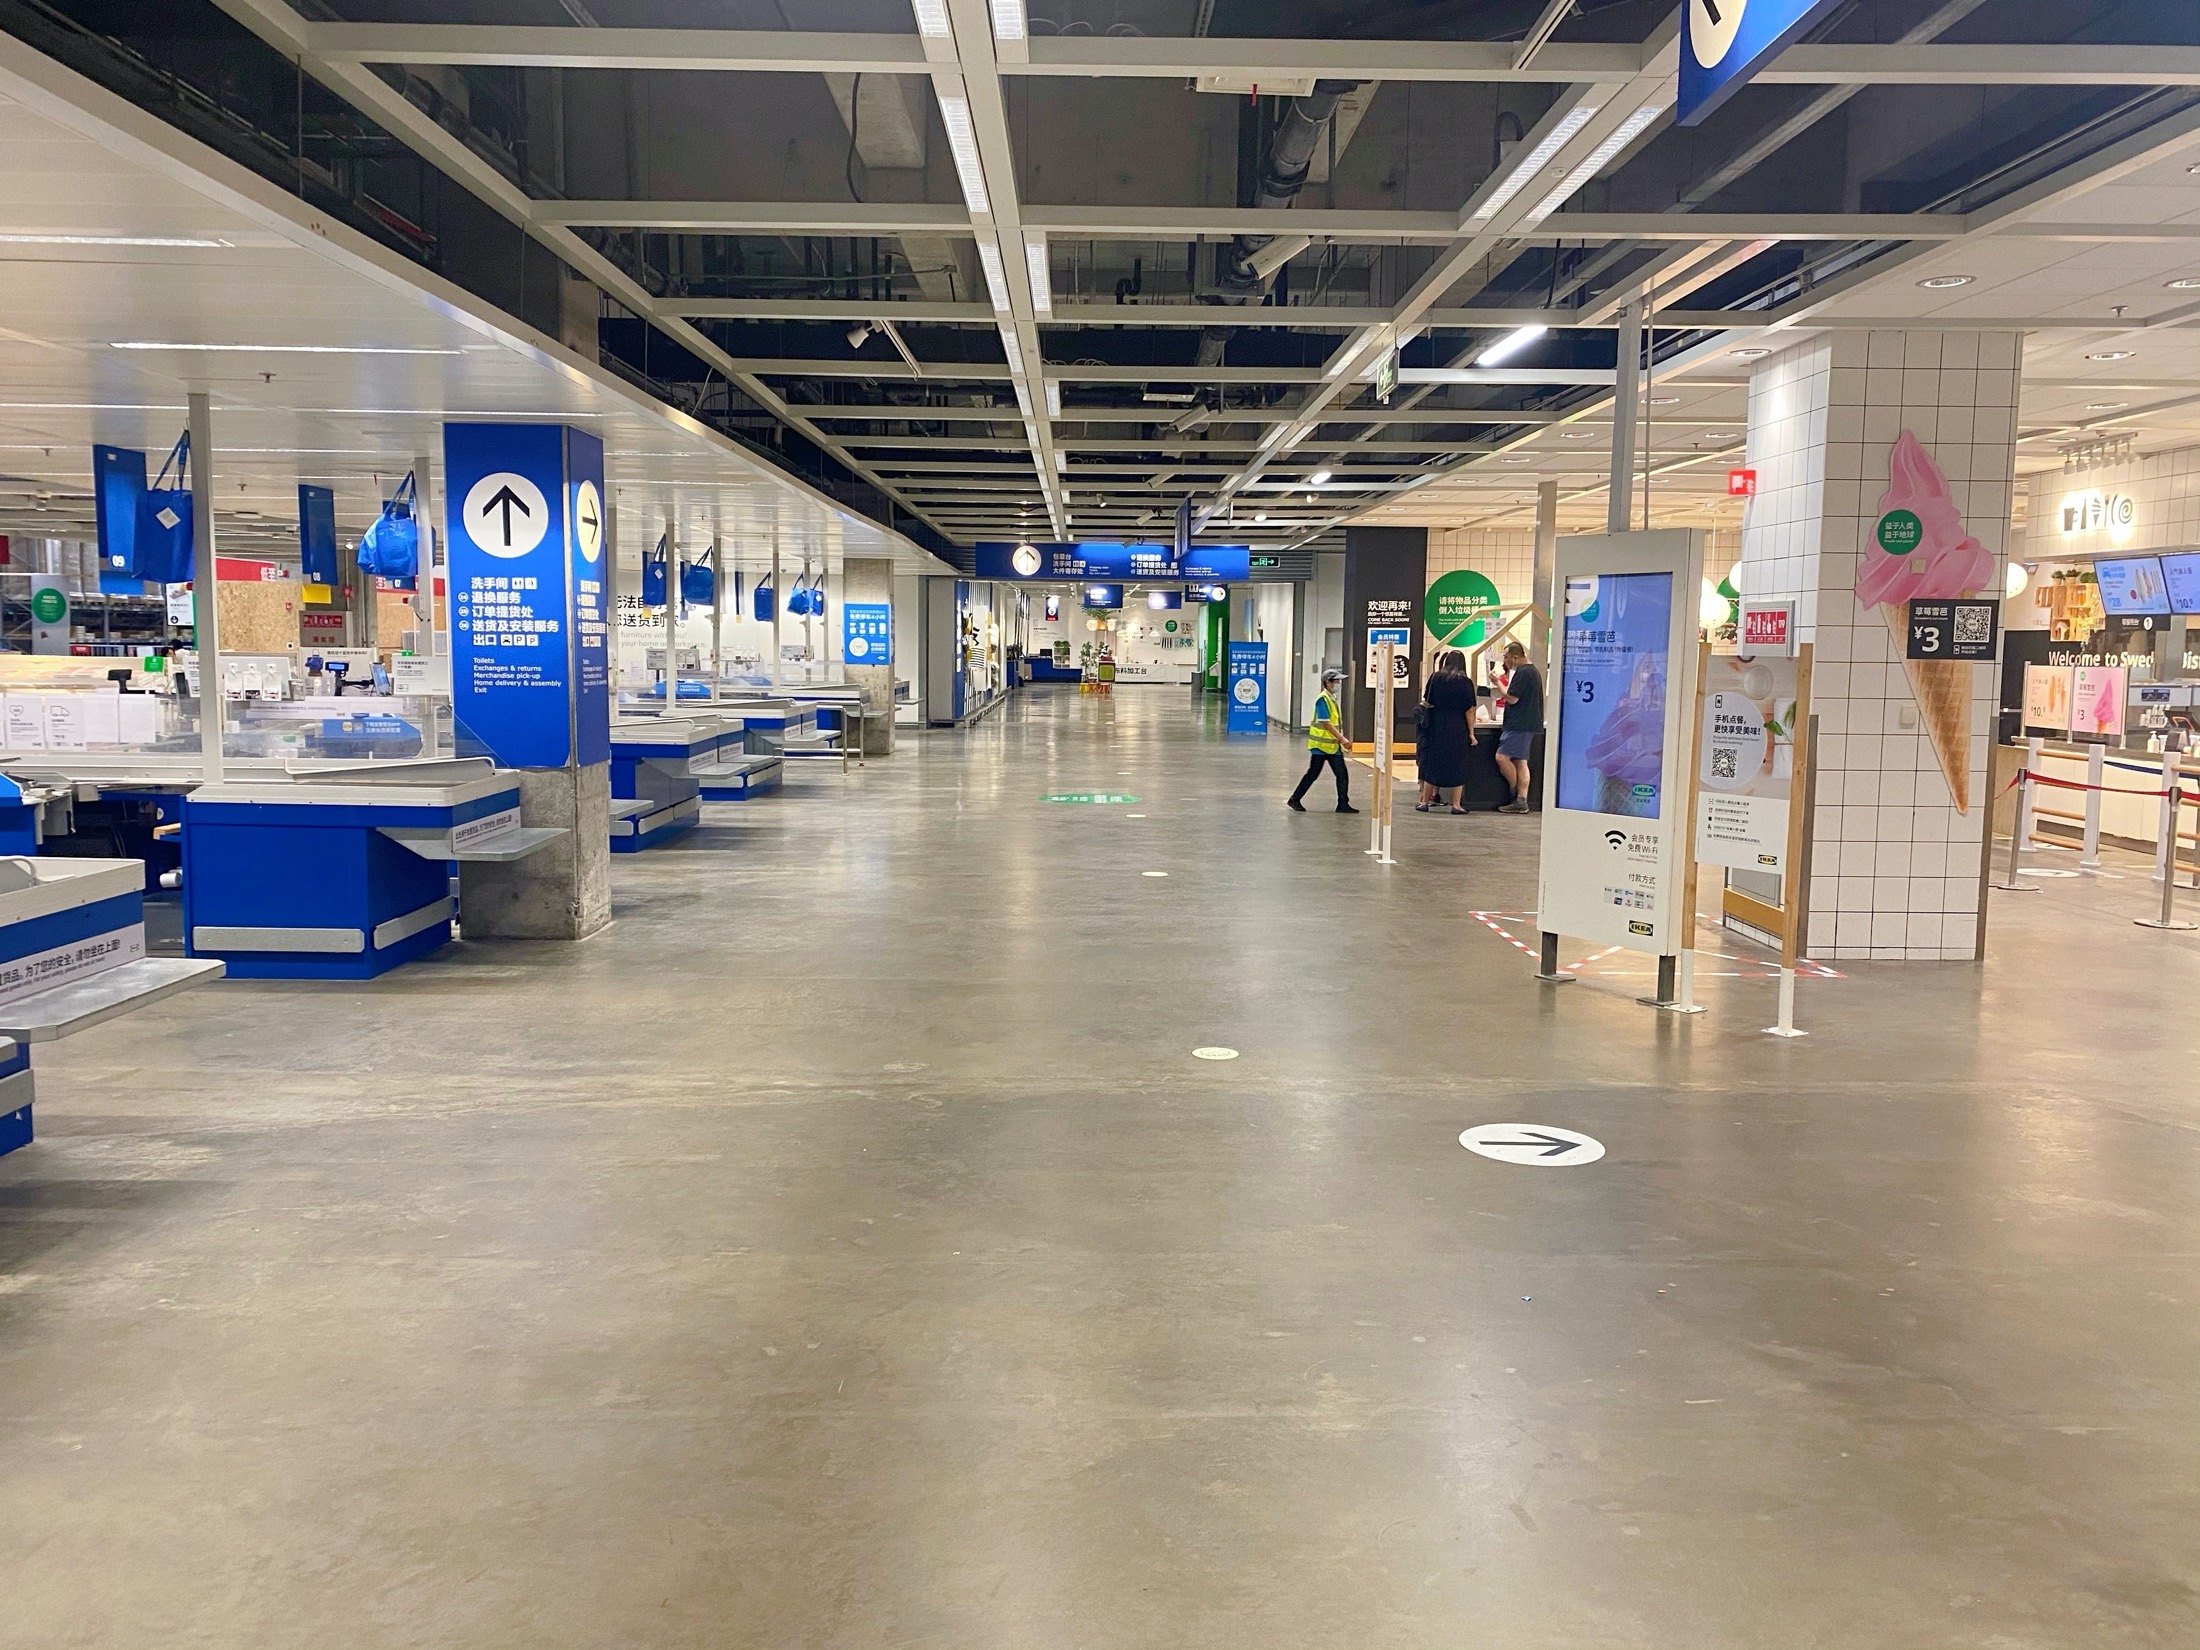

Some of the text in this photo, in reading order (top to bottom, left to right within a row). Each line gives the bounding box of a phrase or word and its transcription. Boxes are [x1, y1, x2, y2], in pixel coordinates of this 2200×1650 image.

[1885, 521, 1914, 529] 益于人类
[1885, 530, 1914, 539] 益于地球
[112, 554, 125, 567] 09
[471, 577, 508, 590] 洗手间
[471, 591, 521, 604] 退换服务
[1439, 596, 1488, 605] 请将物品分类
[1367, 600, 1411, 611] 欢迎再来!
[1914, 606, 1948, 616] 草莓雪芭
[472, 606, 534, 618] 订单提货处
[472, 620, 559, 632] 送货及安装服务
[473, 634, 497, 646] 出口
[674, 631, 688, 639] ou?
[1914, 626, 1940, 653] ¥3
[674, 640, 708, 648] orkplace.
[2048, 650, 2101, 667] Welcome
[2104, 652, 2118, 667] to
[473, 665, 509, 673] Exchanges
[516, 672, 541, 680] pick-up
[530, 680, 562, 688] assembly
[1576, 680, 1595, 703] ¥3
[1714, 714, 1746, 725] 手机点餐,
[1714, 724, 1761, 735] 更快享受美味!
[1631, 834, 1659, 844] 会员专享
[1628, 872, 1656, 885] 付款方式
